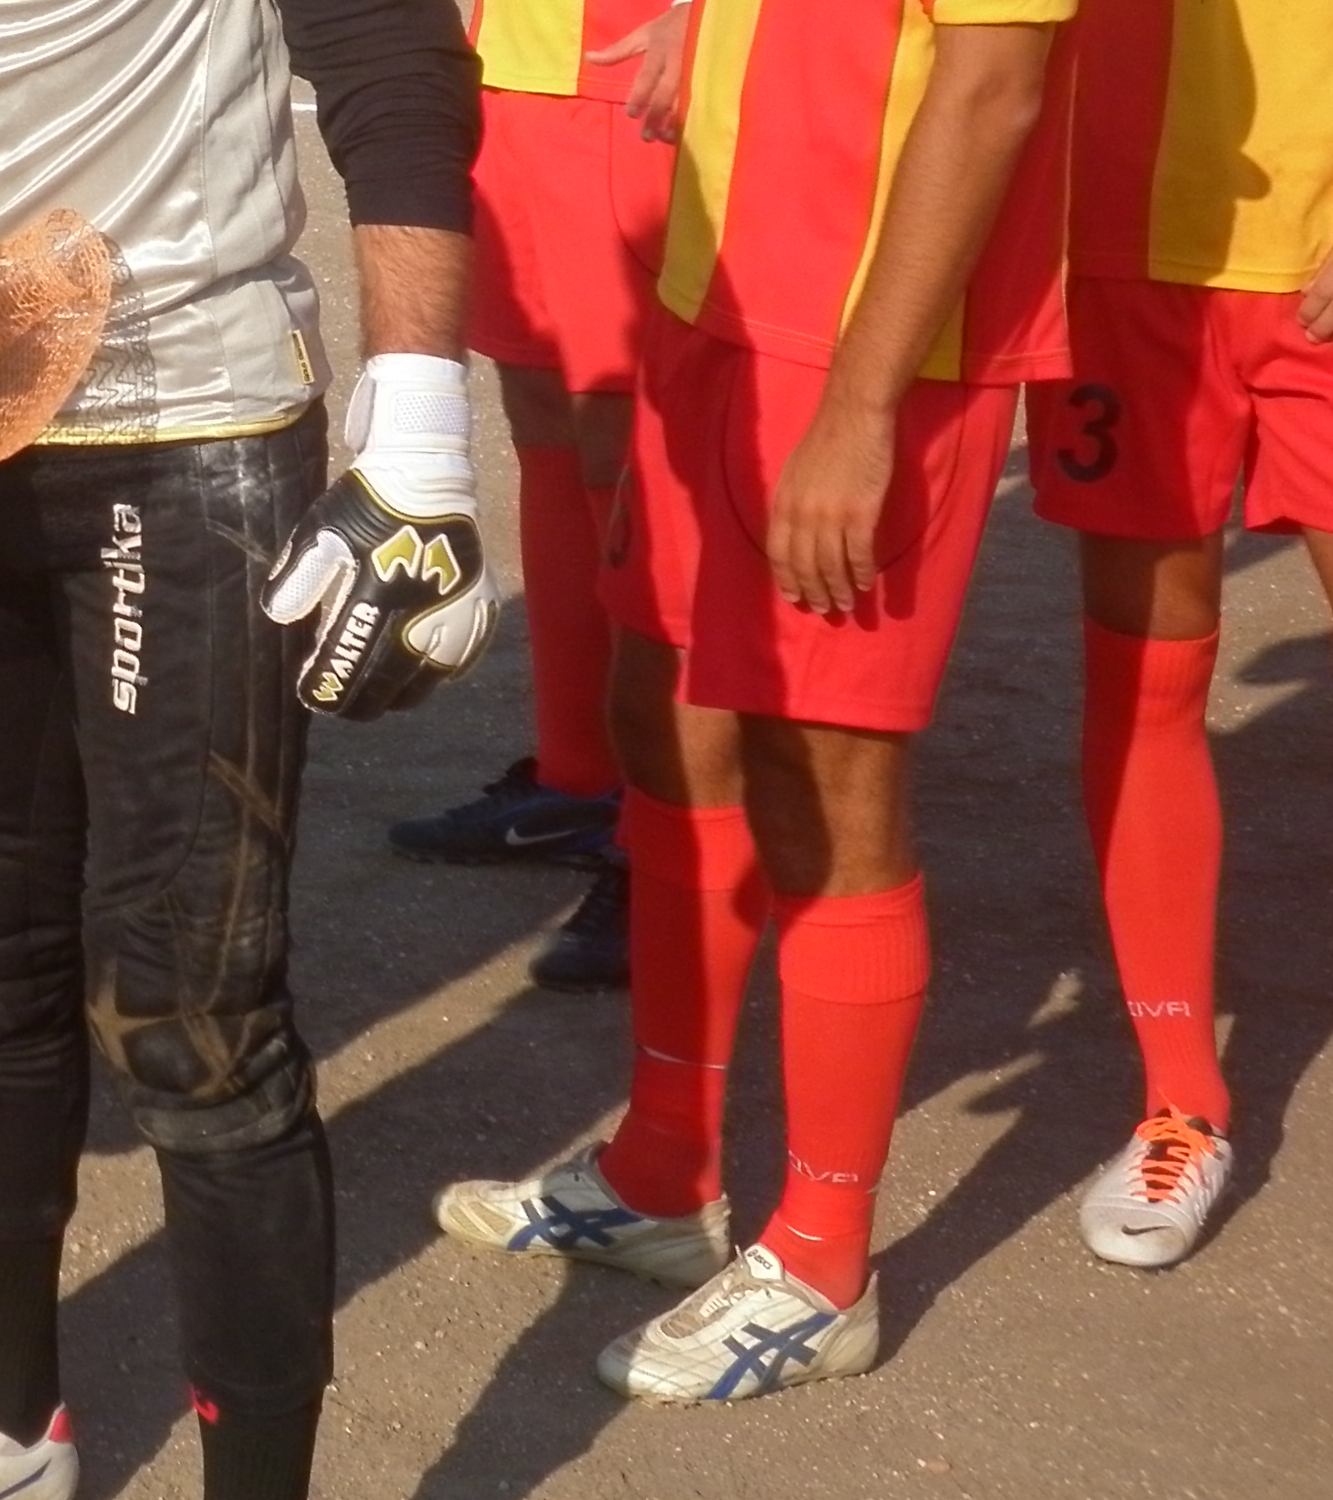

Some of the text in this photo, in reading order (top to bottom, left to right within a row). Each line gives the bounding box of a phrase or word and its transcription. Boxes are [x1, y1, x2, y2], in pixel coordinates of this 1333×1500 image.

[1057, 383, 1122, 484] 3
[100, 502, 148, 715] sportika
[312, 602, 380, 702] WALTER
